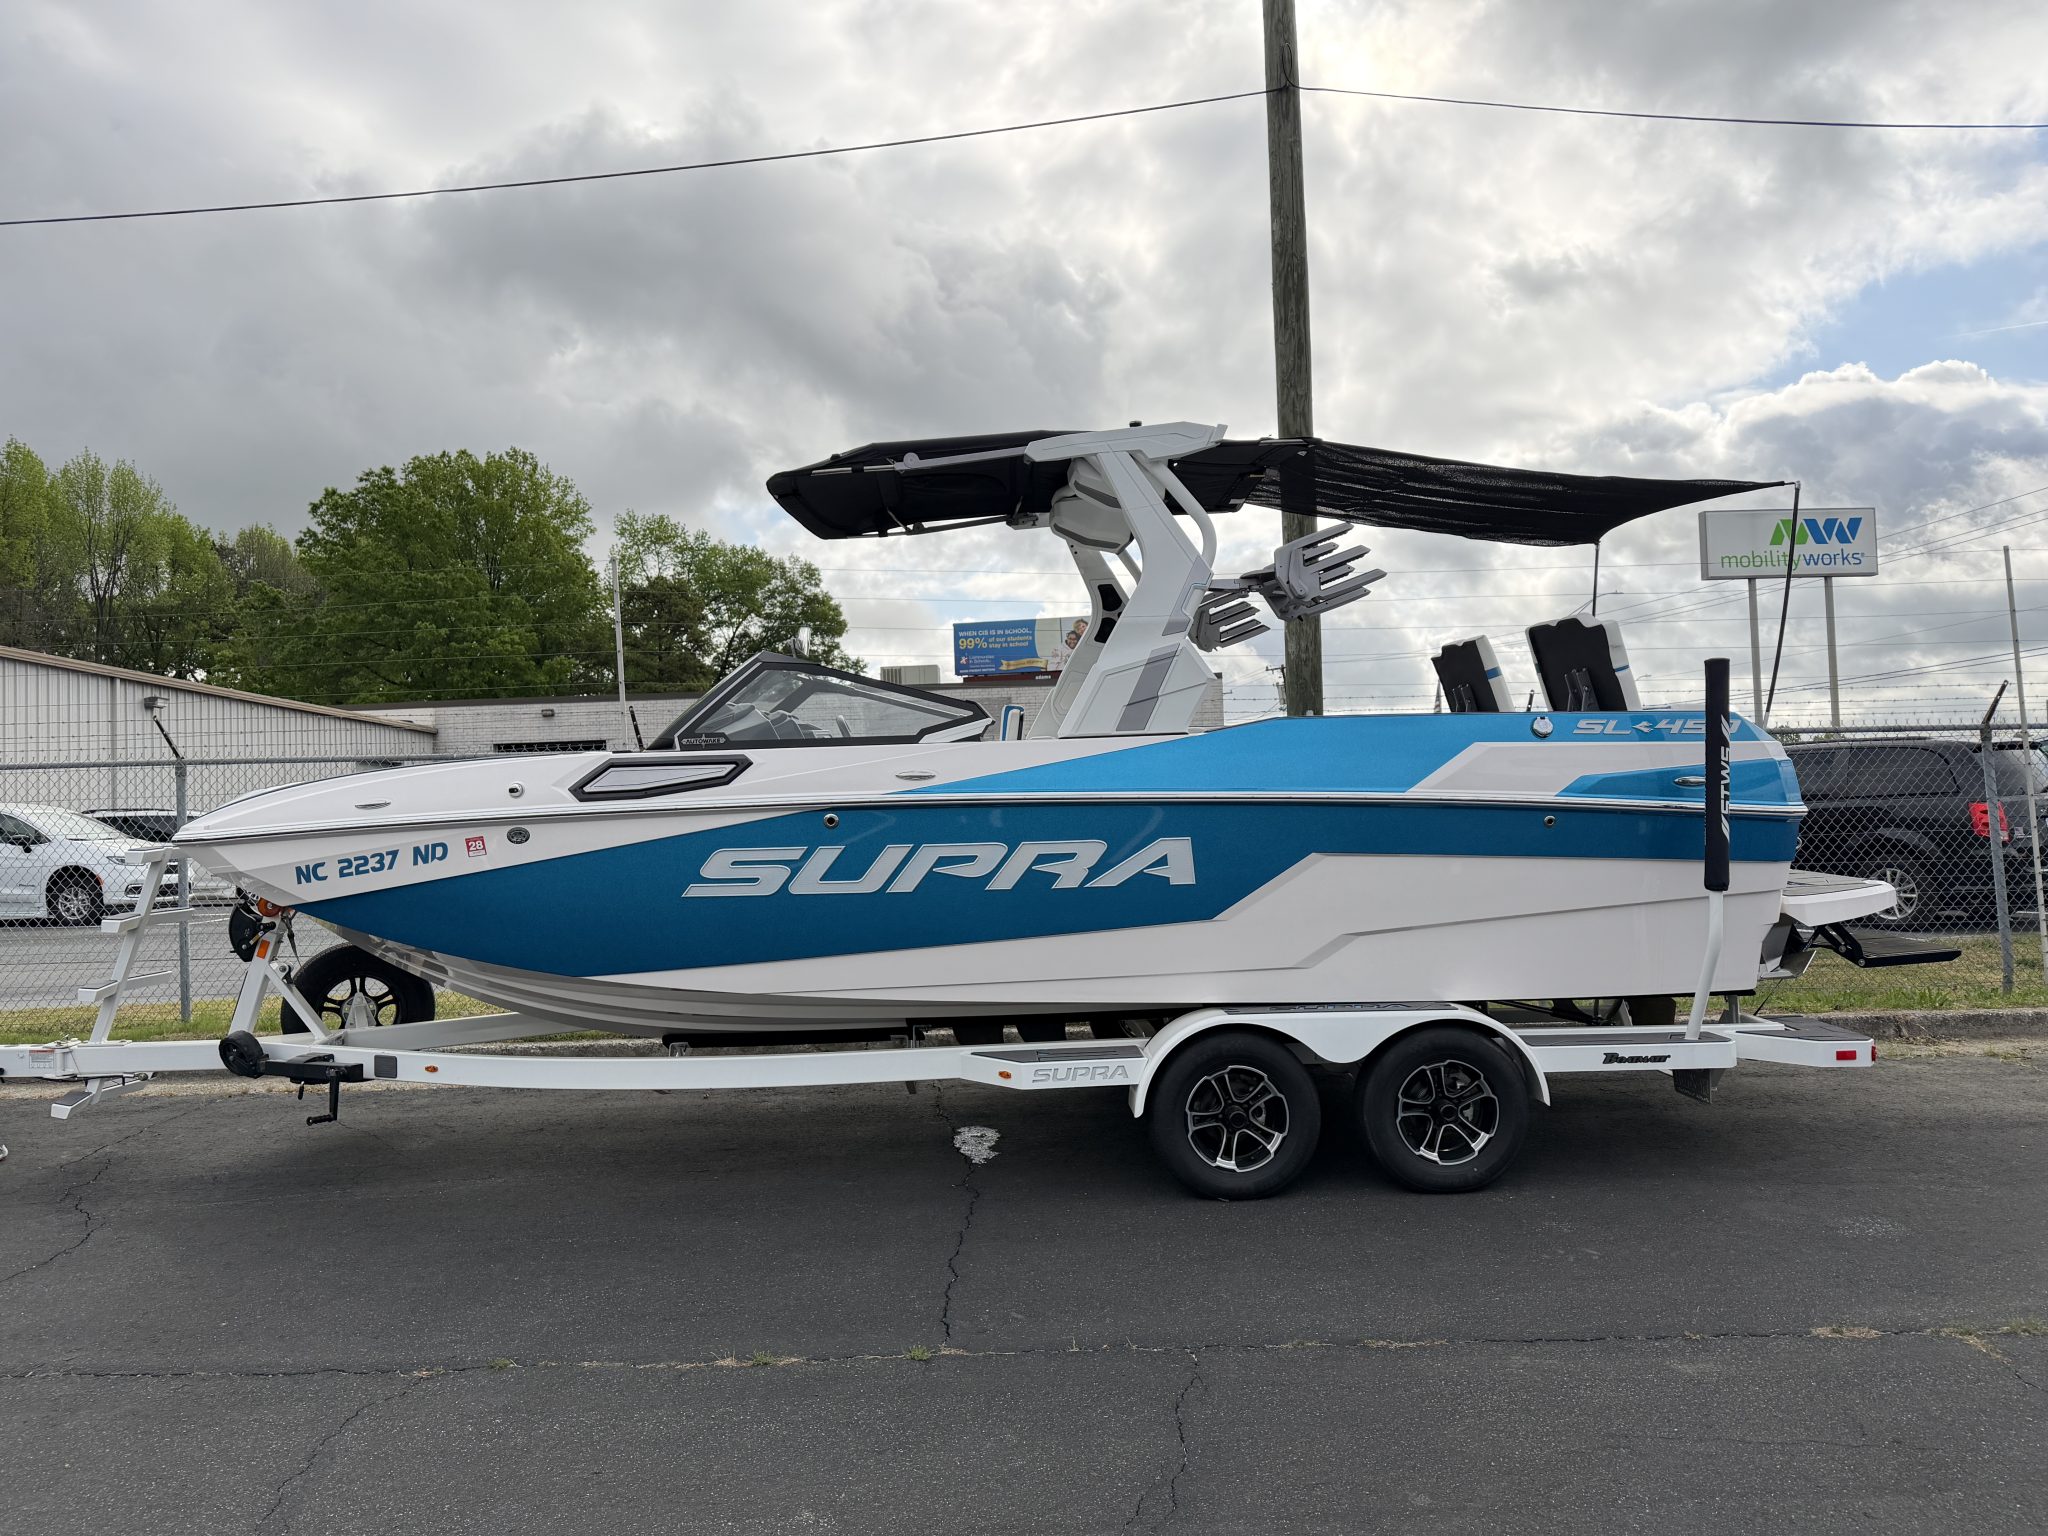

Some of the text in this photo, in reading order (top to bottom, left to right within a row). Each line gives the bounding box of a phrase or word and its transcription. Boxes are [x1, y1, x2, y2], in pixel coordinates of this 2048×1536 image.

[958, 637, 987, 649] 99%
[1573, 719, 1631, 735] SL
[468, 840, 484, 851] 28
[295, 842, 448, 884] NC 2237 ND
[681, 836, 1197, 898] SUPRA
[1031, 1065, 1129, 1083] SUPRA
